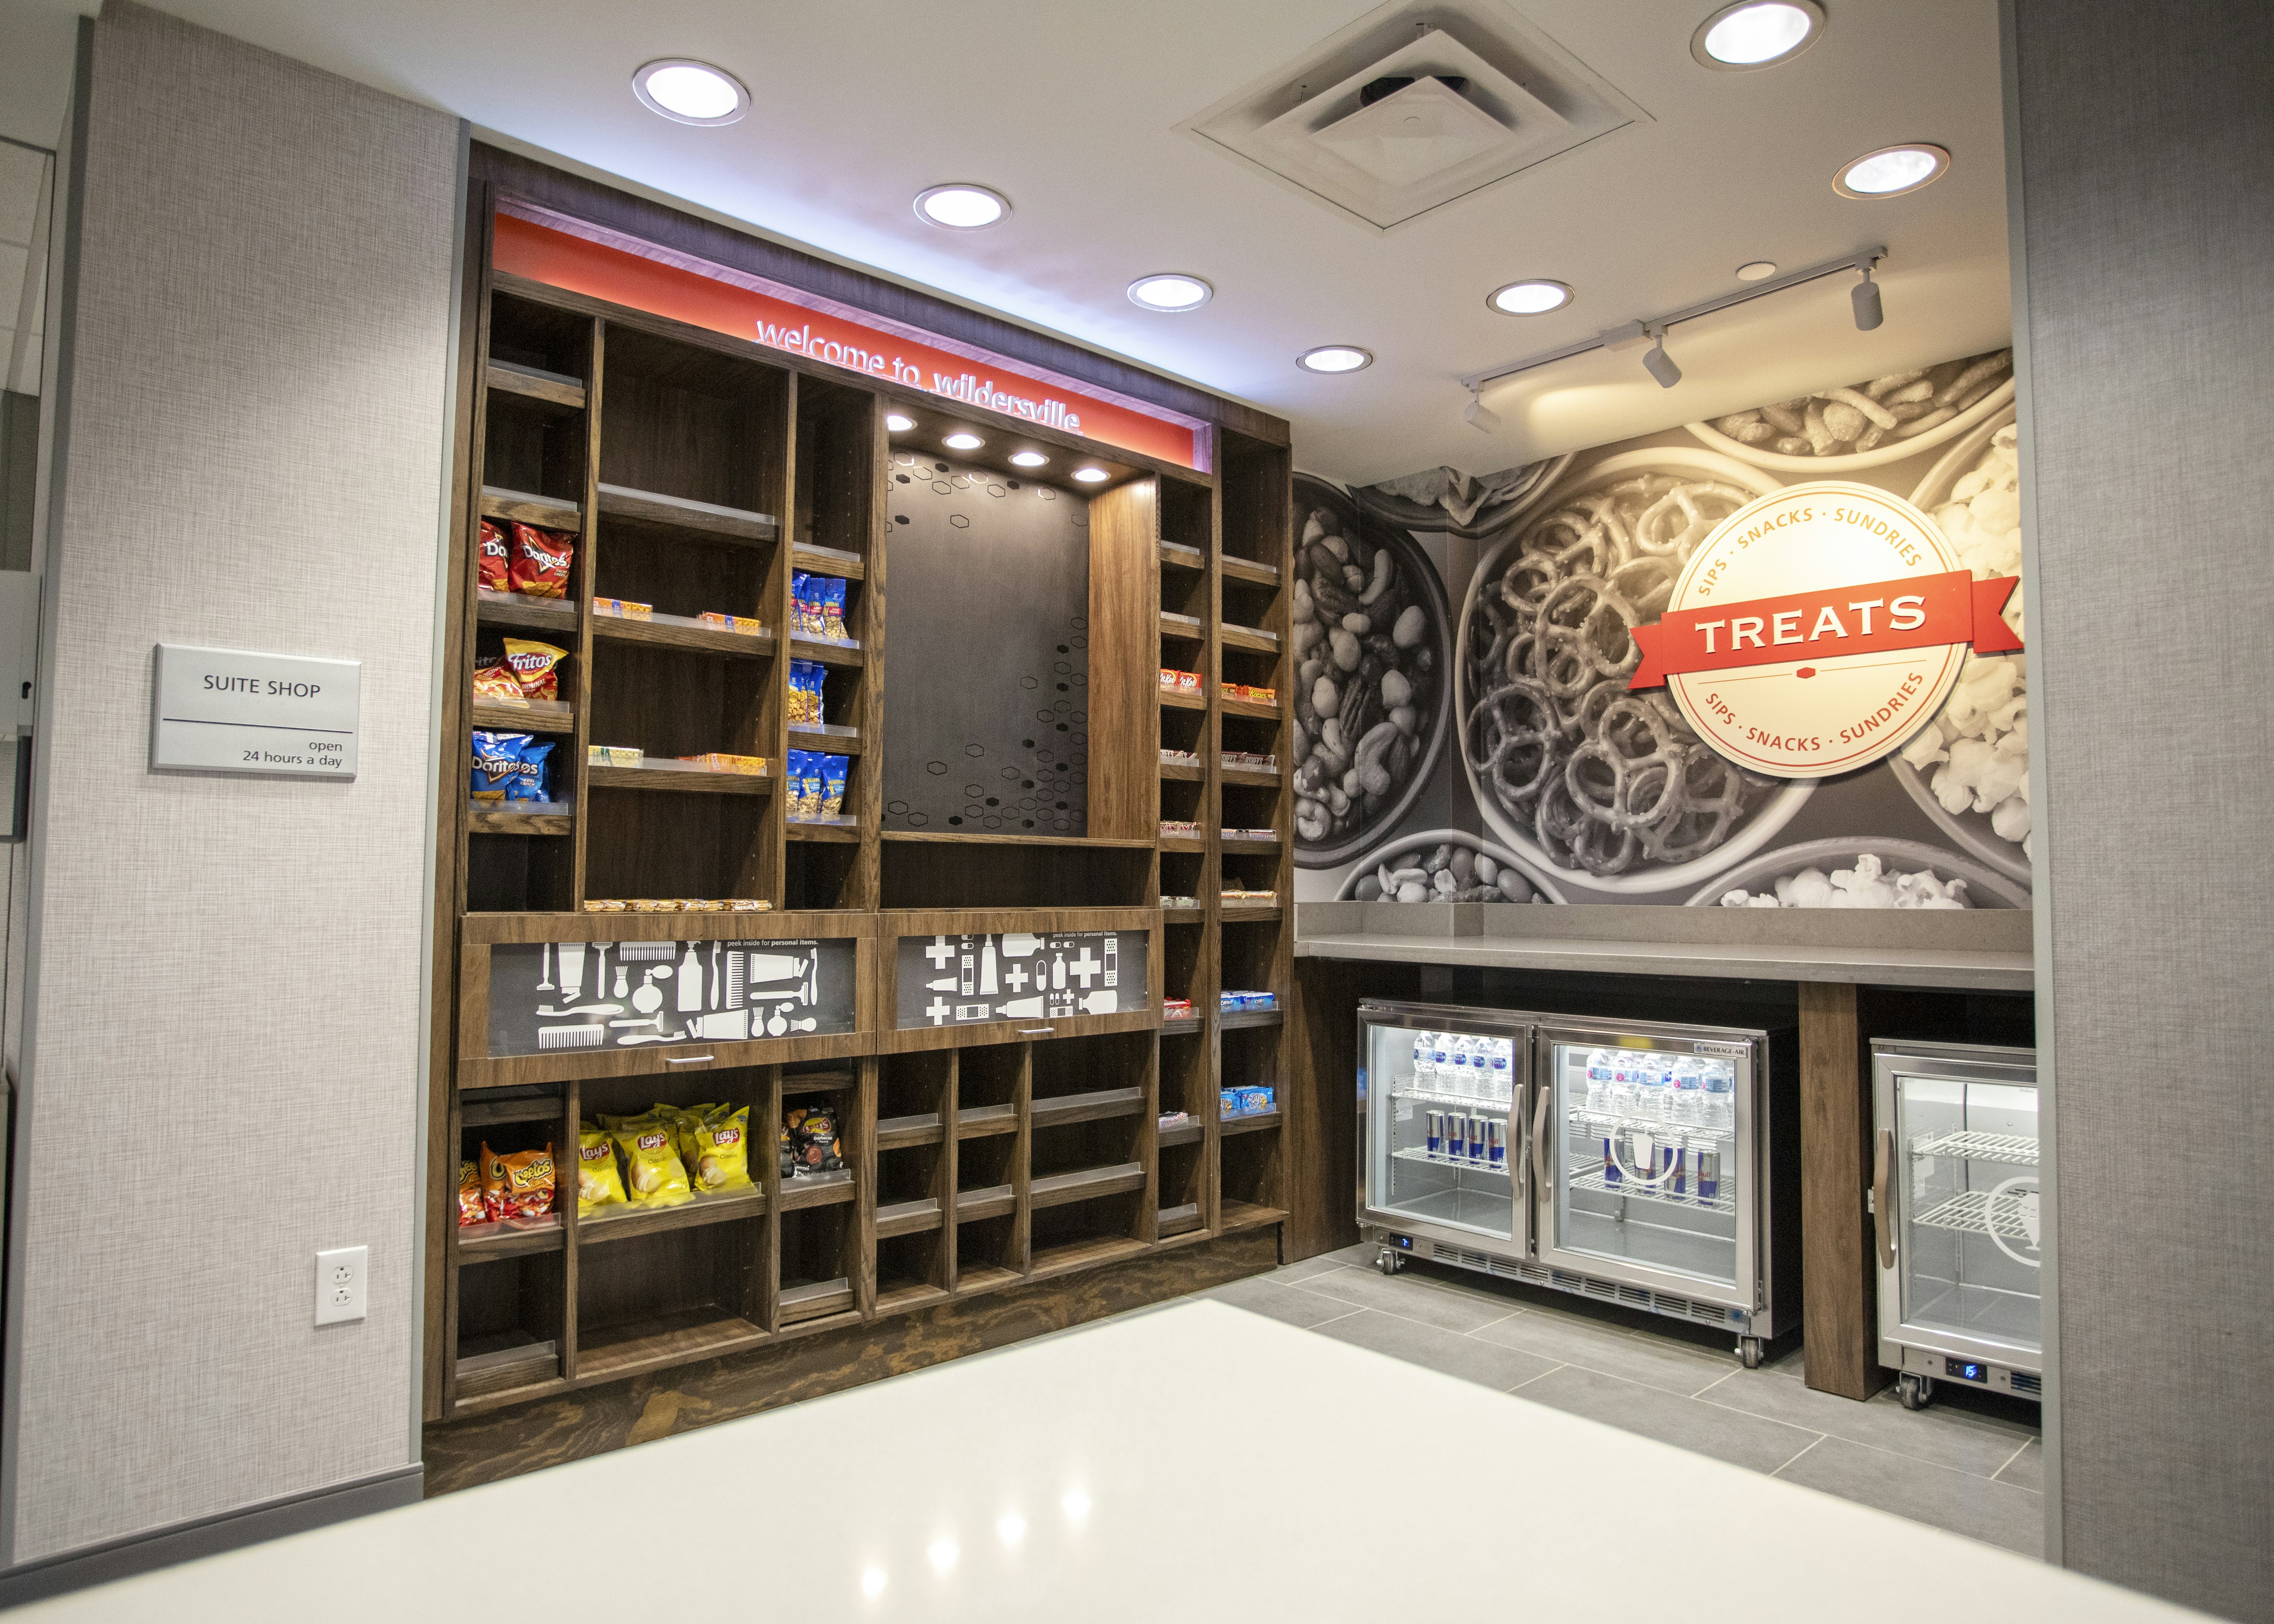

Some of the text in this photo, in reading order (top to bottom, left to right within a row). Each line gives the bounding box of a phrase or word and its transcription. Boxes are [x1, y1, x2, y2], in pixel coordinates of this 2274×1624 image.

[756, 320, 1081, 431] welcome to wildersville
[1698, 507, 1922, 596] SIPS SNACKS SUNDRIES
[1695, 596, 1926, 654] TREATS
[508, 653, 552, 671] Fritos
[204, 675, 321, 698] SUITE SHOP
[521, 678, 546, 690] ORIGINAL
[1706, 672, 1923, 752] SIPS SNACKS SUNDRIES
[309, 742, 343, 752] open
[243, 751, 260, 761] 24
[264, 751, 302, 764] hours
[319, 755, 342, 768] day
[1703, 1047, 1744, 1055] BEVERAGE-AIR
